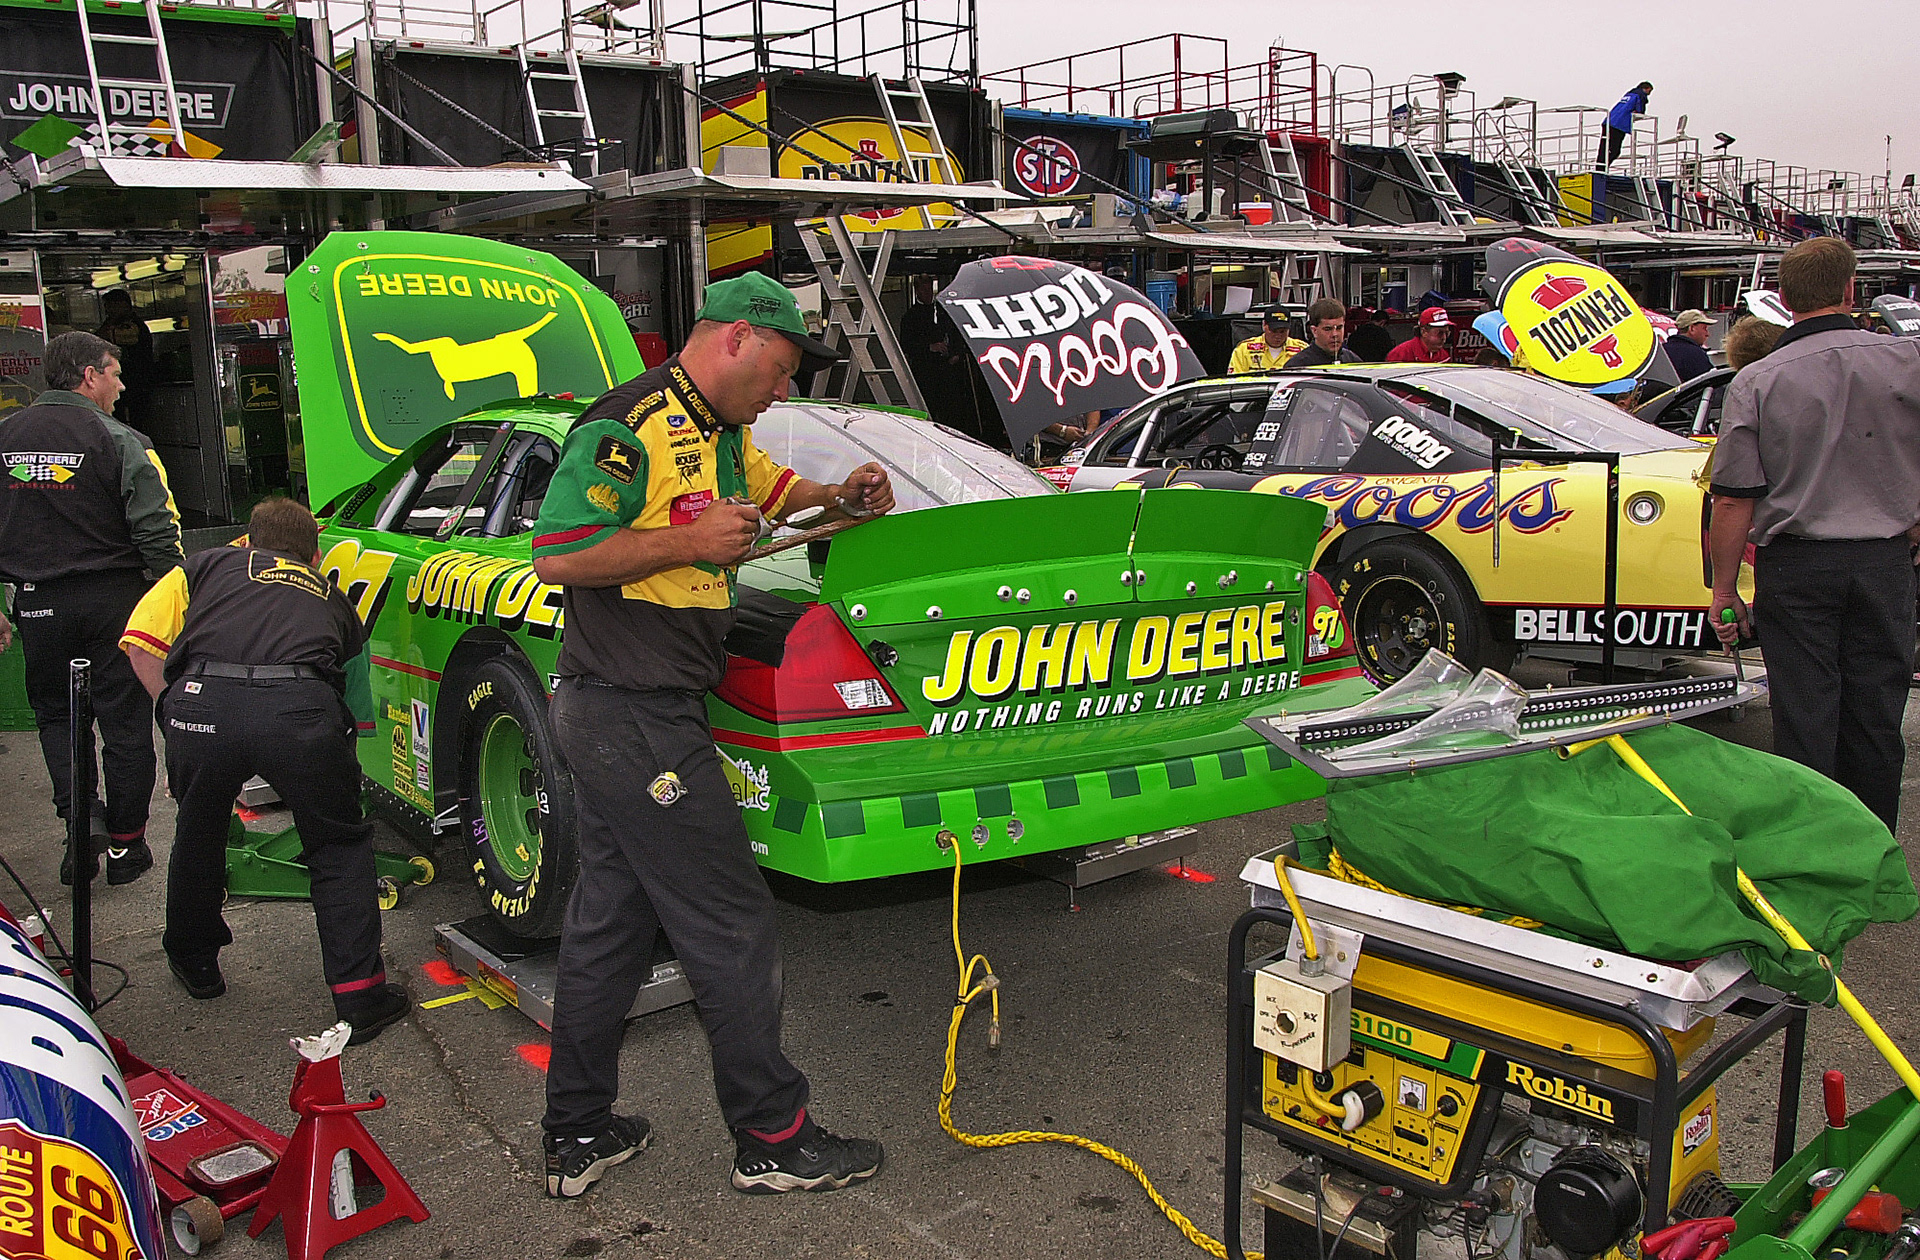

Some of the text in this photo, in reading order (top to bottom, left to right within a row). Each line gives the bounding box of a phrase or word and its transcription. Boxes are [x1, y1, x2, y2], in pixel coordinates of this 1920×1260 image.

[9, 83, 215, 119] JOHN DEERE
[1022, 143, 1071, 185] STP
[356, 274, 560, 307] JOHN DEERE
[953, 267, 1114, 339] LIGHT
[1528, 284, 1632, 362] PENNZOIL
[979, 301, 1188, 407] Coors
[669, 365, 716, 426] JOHN DEERE
[8, 455, 77, 465] JOHN DEERE
[675, 453, 702, 466] ROUSH
[1375, 476, 1450, 486] ORIGINAL
[1279, 474, 1575, 535] Coors
[256, 571, 287, 580] JOHN
[406, 549, 565, 630] JOHN DE
[1313, 609, 1338, 641] 97
[1514, 609, 1705, 646] BELLSOUTH
[922, 600, 1289, 703] JOHN DEERE
[467, 681, 492, 711] EAGLE
[928, 670, 1301, 737] NOTHING RUNS LIKE A DEERE
[1505, 1060, 1615, 1124] Robin
[146, 1110, 208, 1141] BIG
[0, 1146, 34, 1237] ROUTE
[51, 1164, 120, 1260] 66
